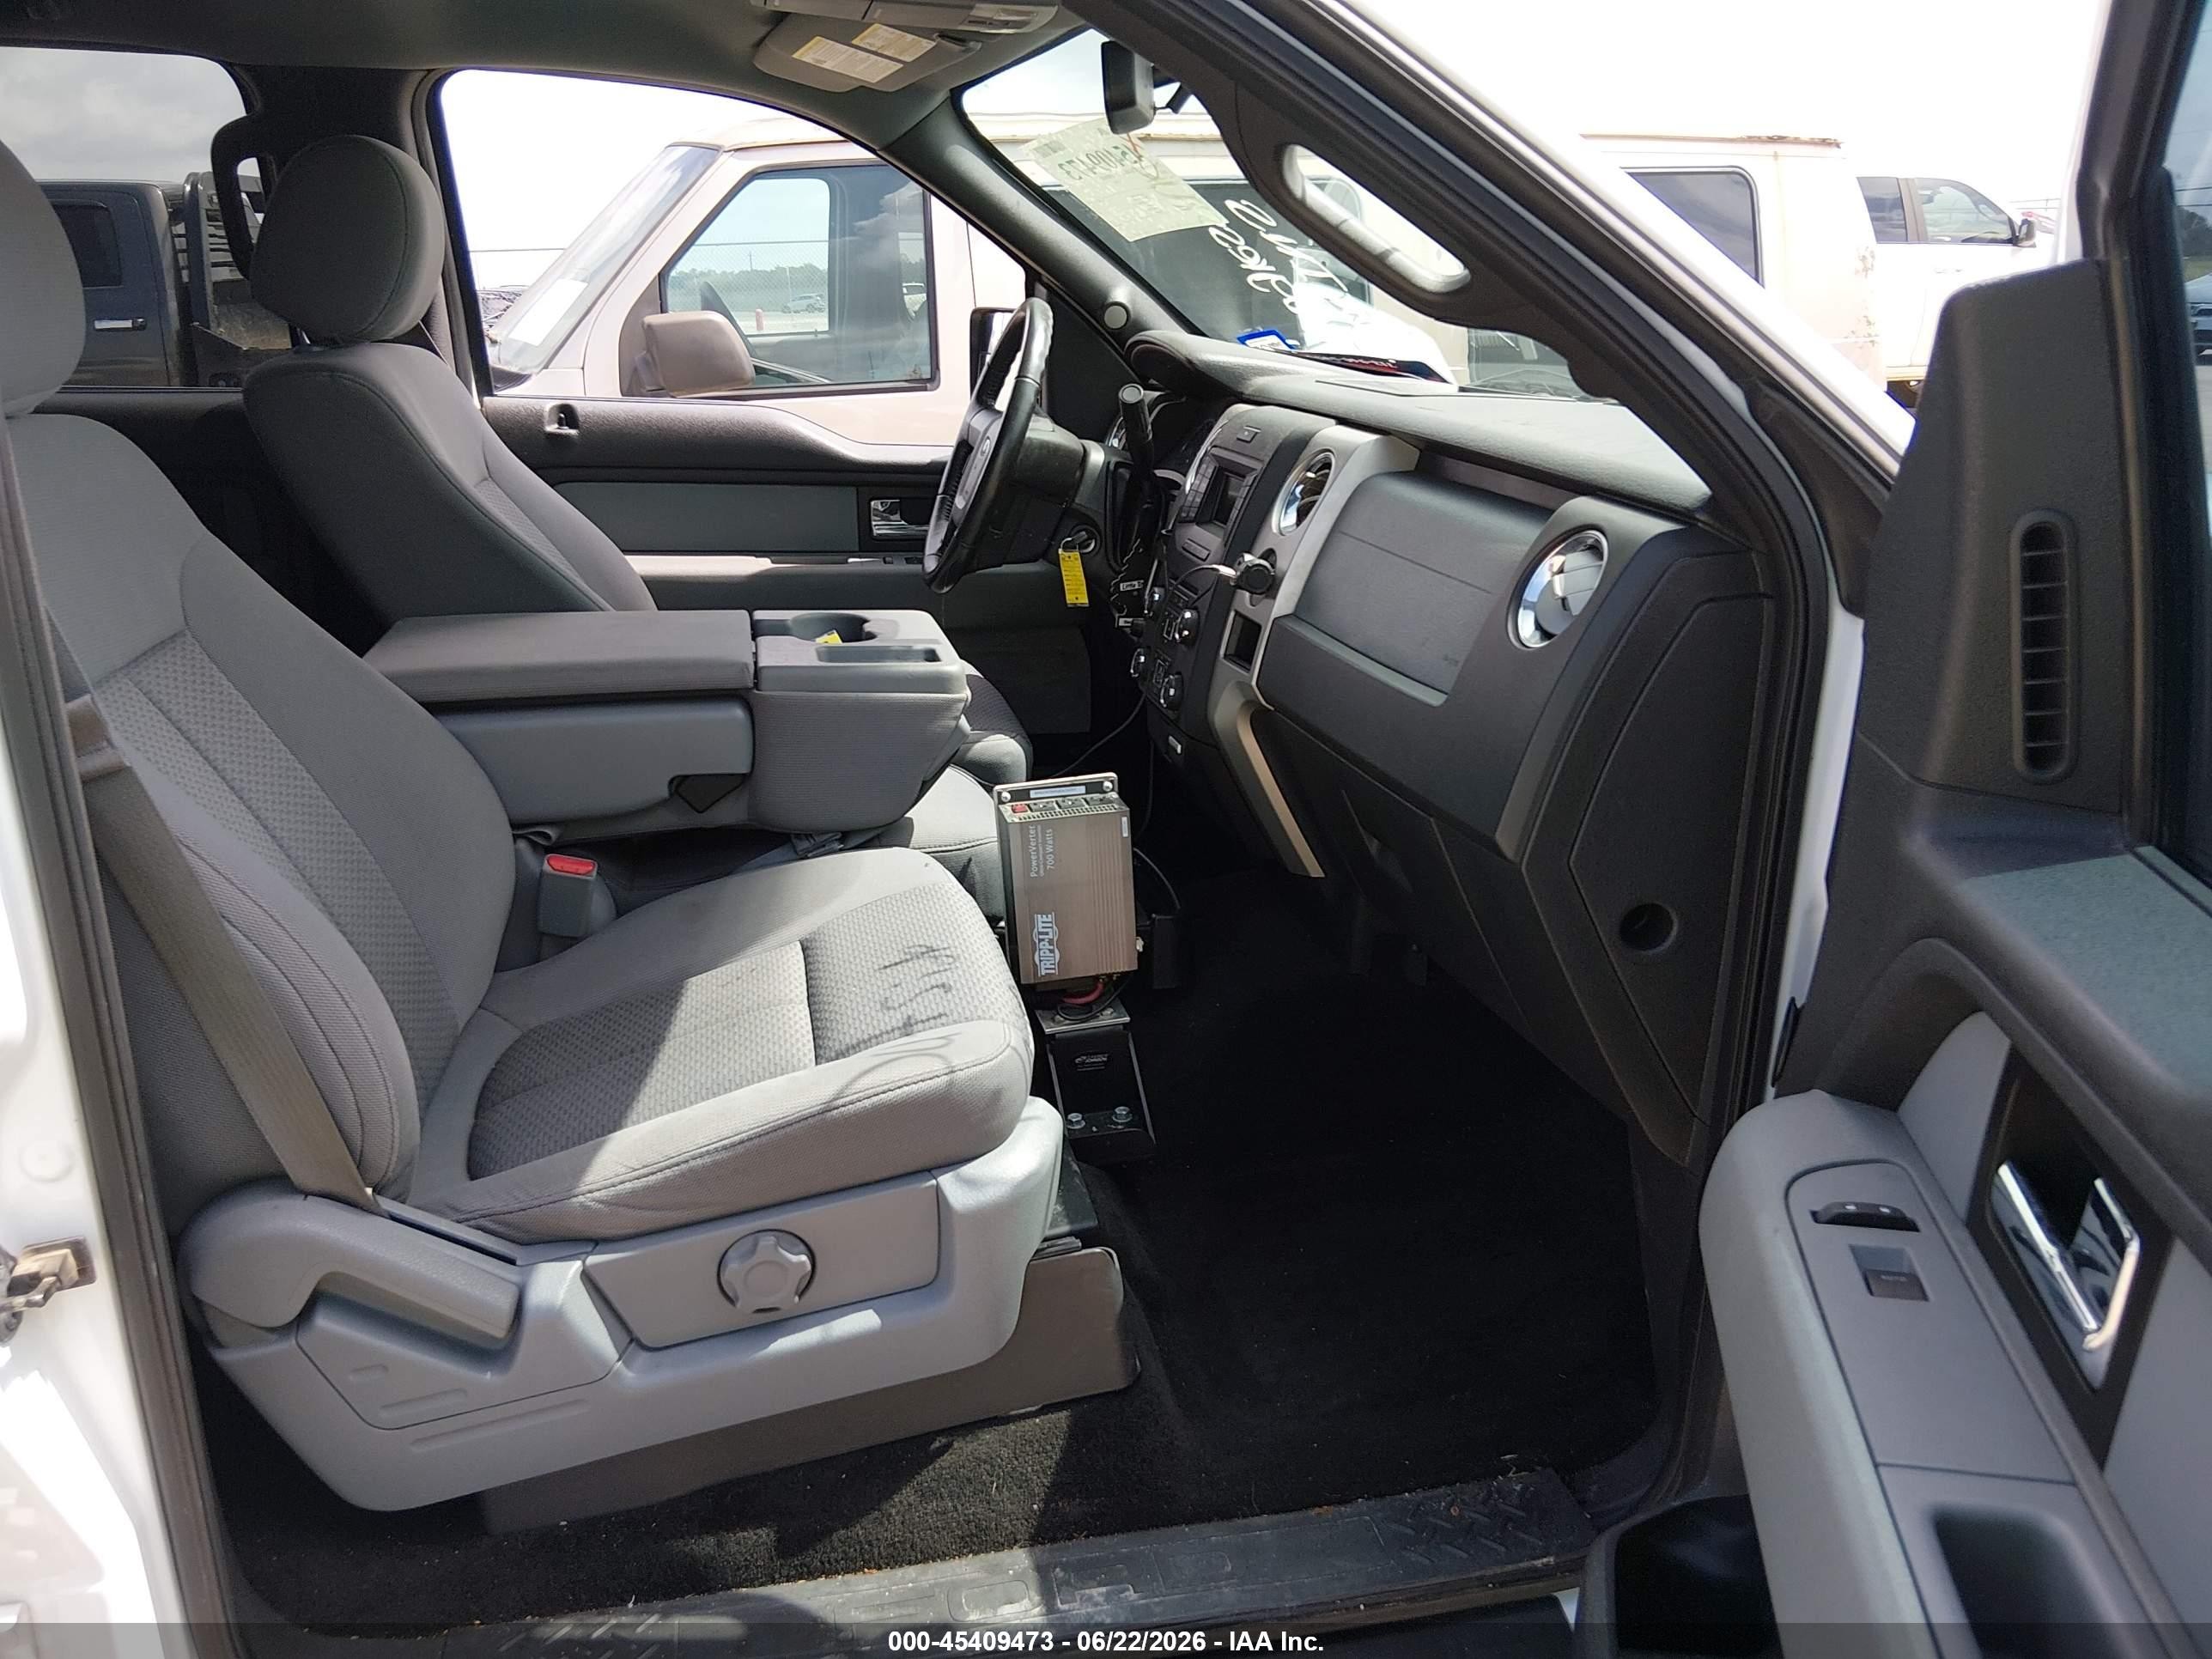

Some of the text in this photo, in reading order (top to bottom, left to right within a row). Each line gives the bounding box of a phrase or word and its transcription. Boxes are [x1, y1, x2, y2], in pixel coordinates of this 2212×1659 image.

[1029, 824, 1039, 878] PowerVerter
[1044, 828, 1055, 871] 700 Watts
